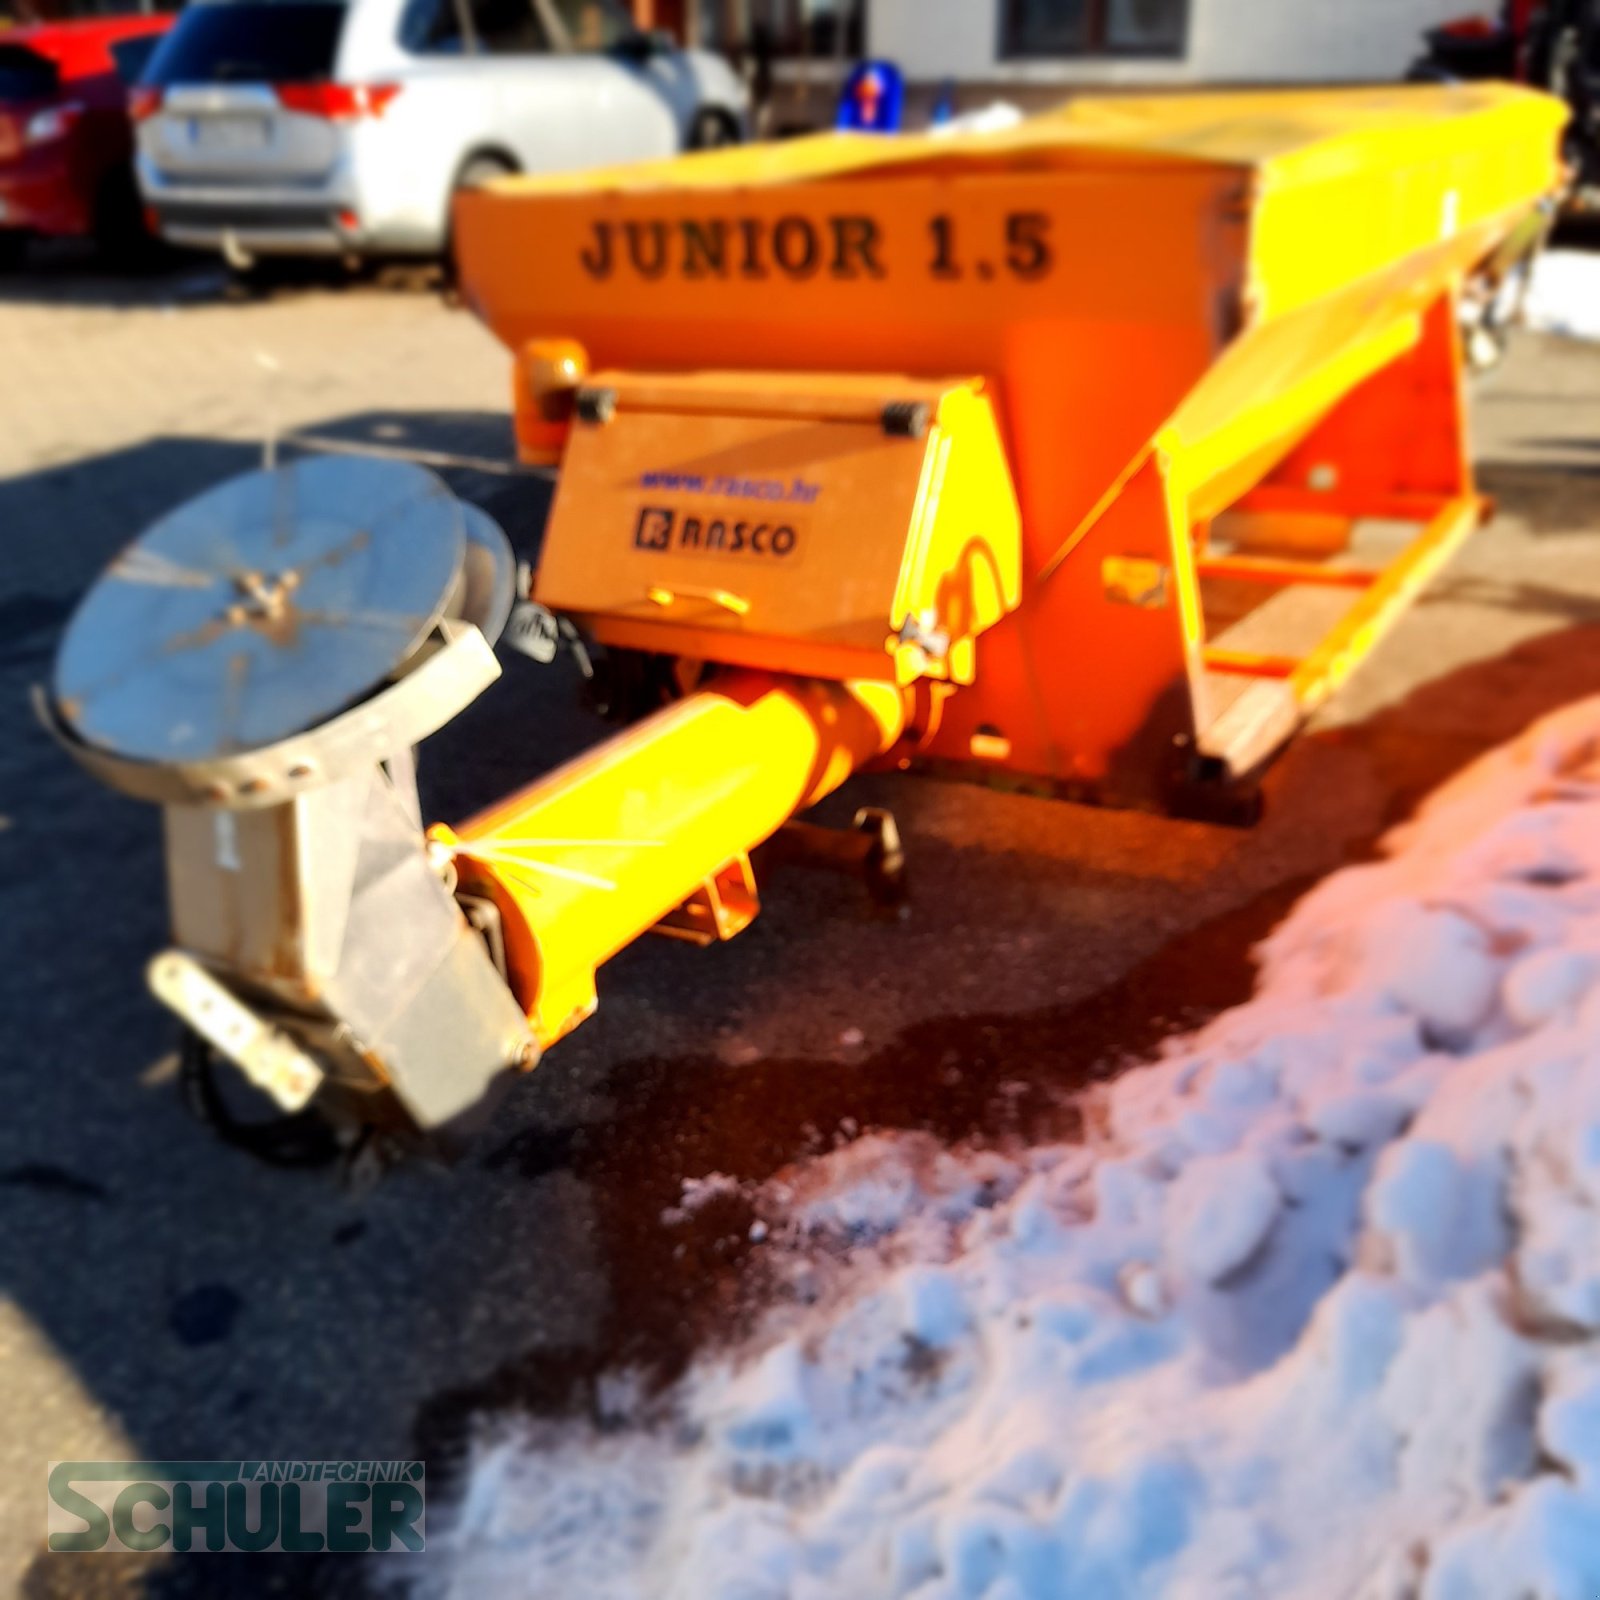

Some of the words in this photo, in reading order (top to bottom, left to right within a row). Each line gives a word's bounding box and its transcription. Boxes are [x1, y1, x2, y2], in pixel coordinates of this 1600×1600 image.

[580, 214, 887, 282] JUNIOR
[928, 211, 1054, 281] 1.5
[640, 470, 821, 504] www.rasco.hr
[681, 515, 797, 556] RASCO
